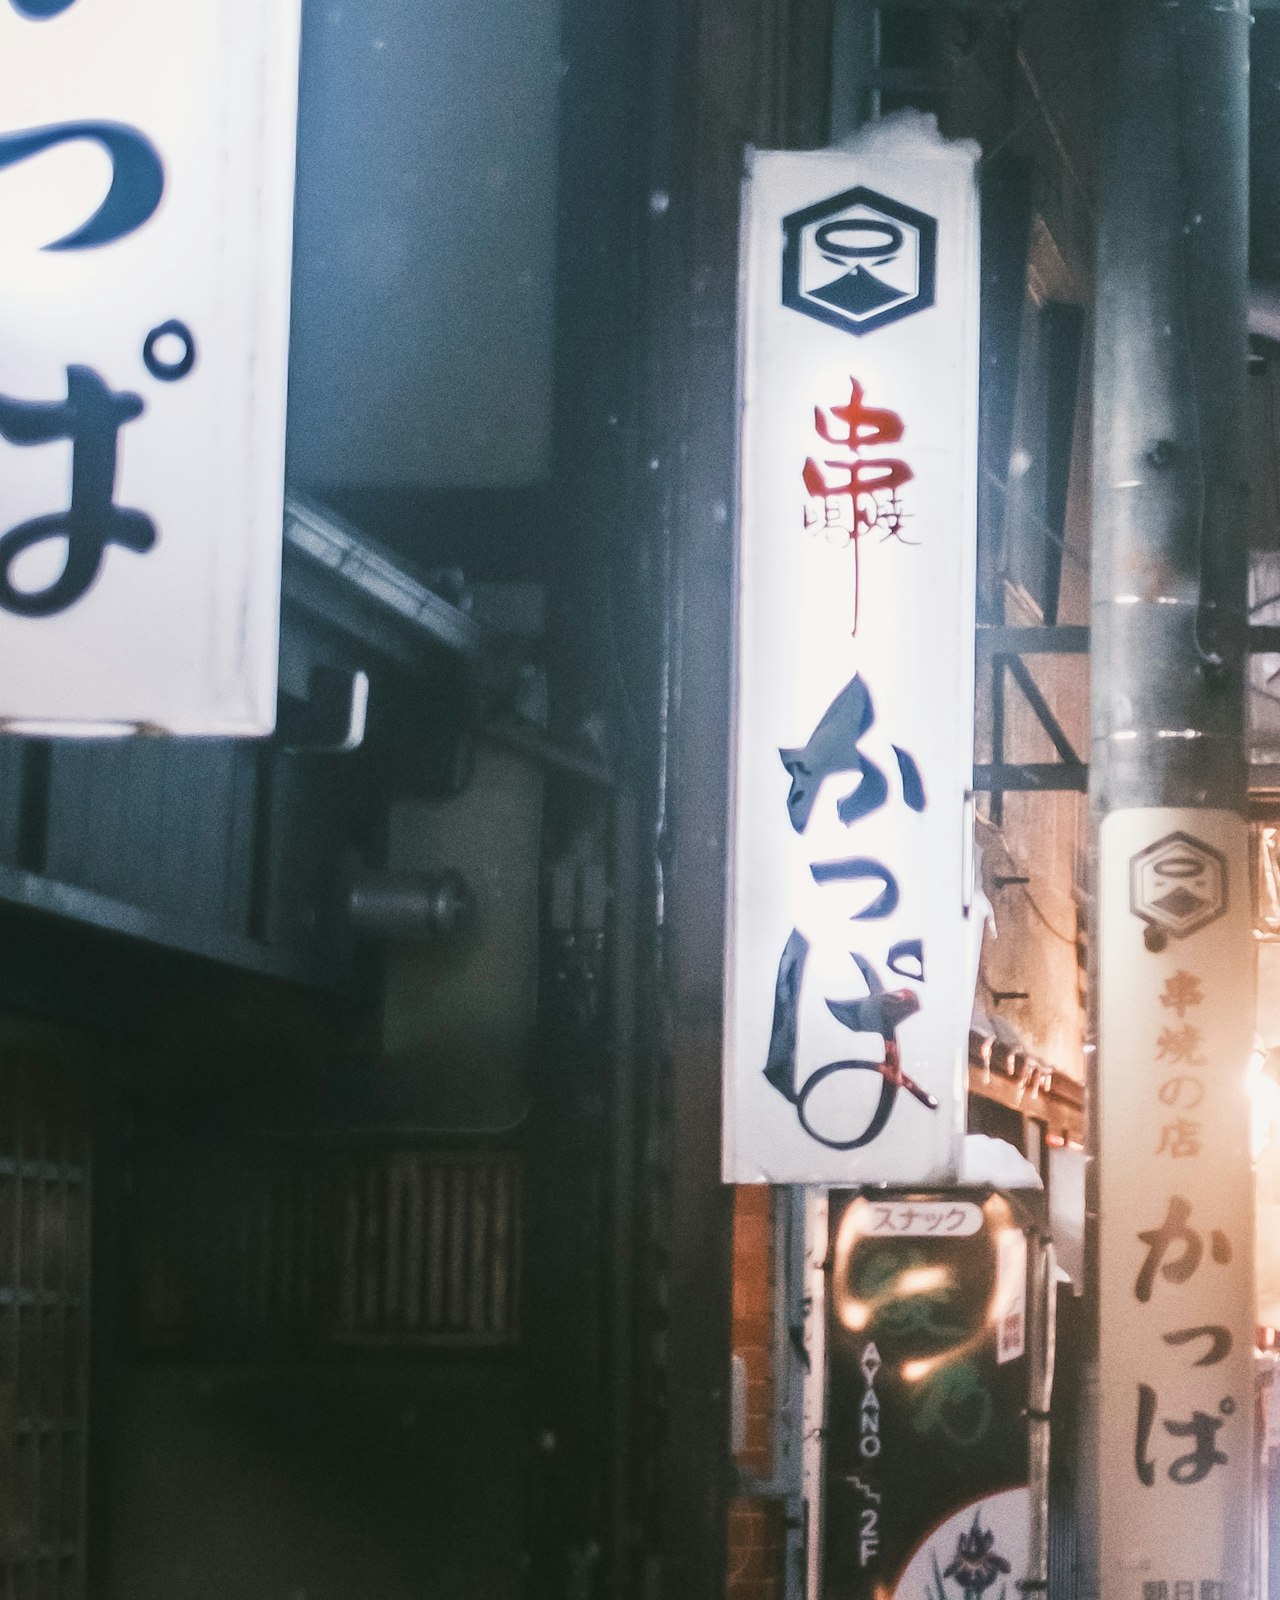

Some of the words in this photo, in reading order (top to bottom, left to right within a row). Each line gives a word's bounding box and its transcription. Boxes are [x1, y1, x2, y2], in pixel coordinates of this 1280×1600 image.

[764, 670, 939, 1150] かっぱ
[858, 1341, 882, 1458] AYANO
[1132, 1195, 1234, 1488] かっぱ
[858, 1510, 880, 1568] 2F
